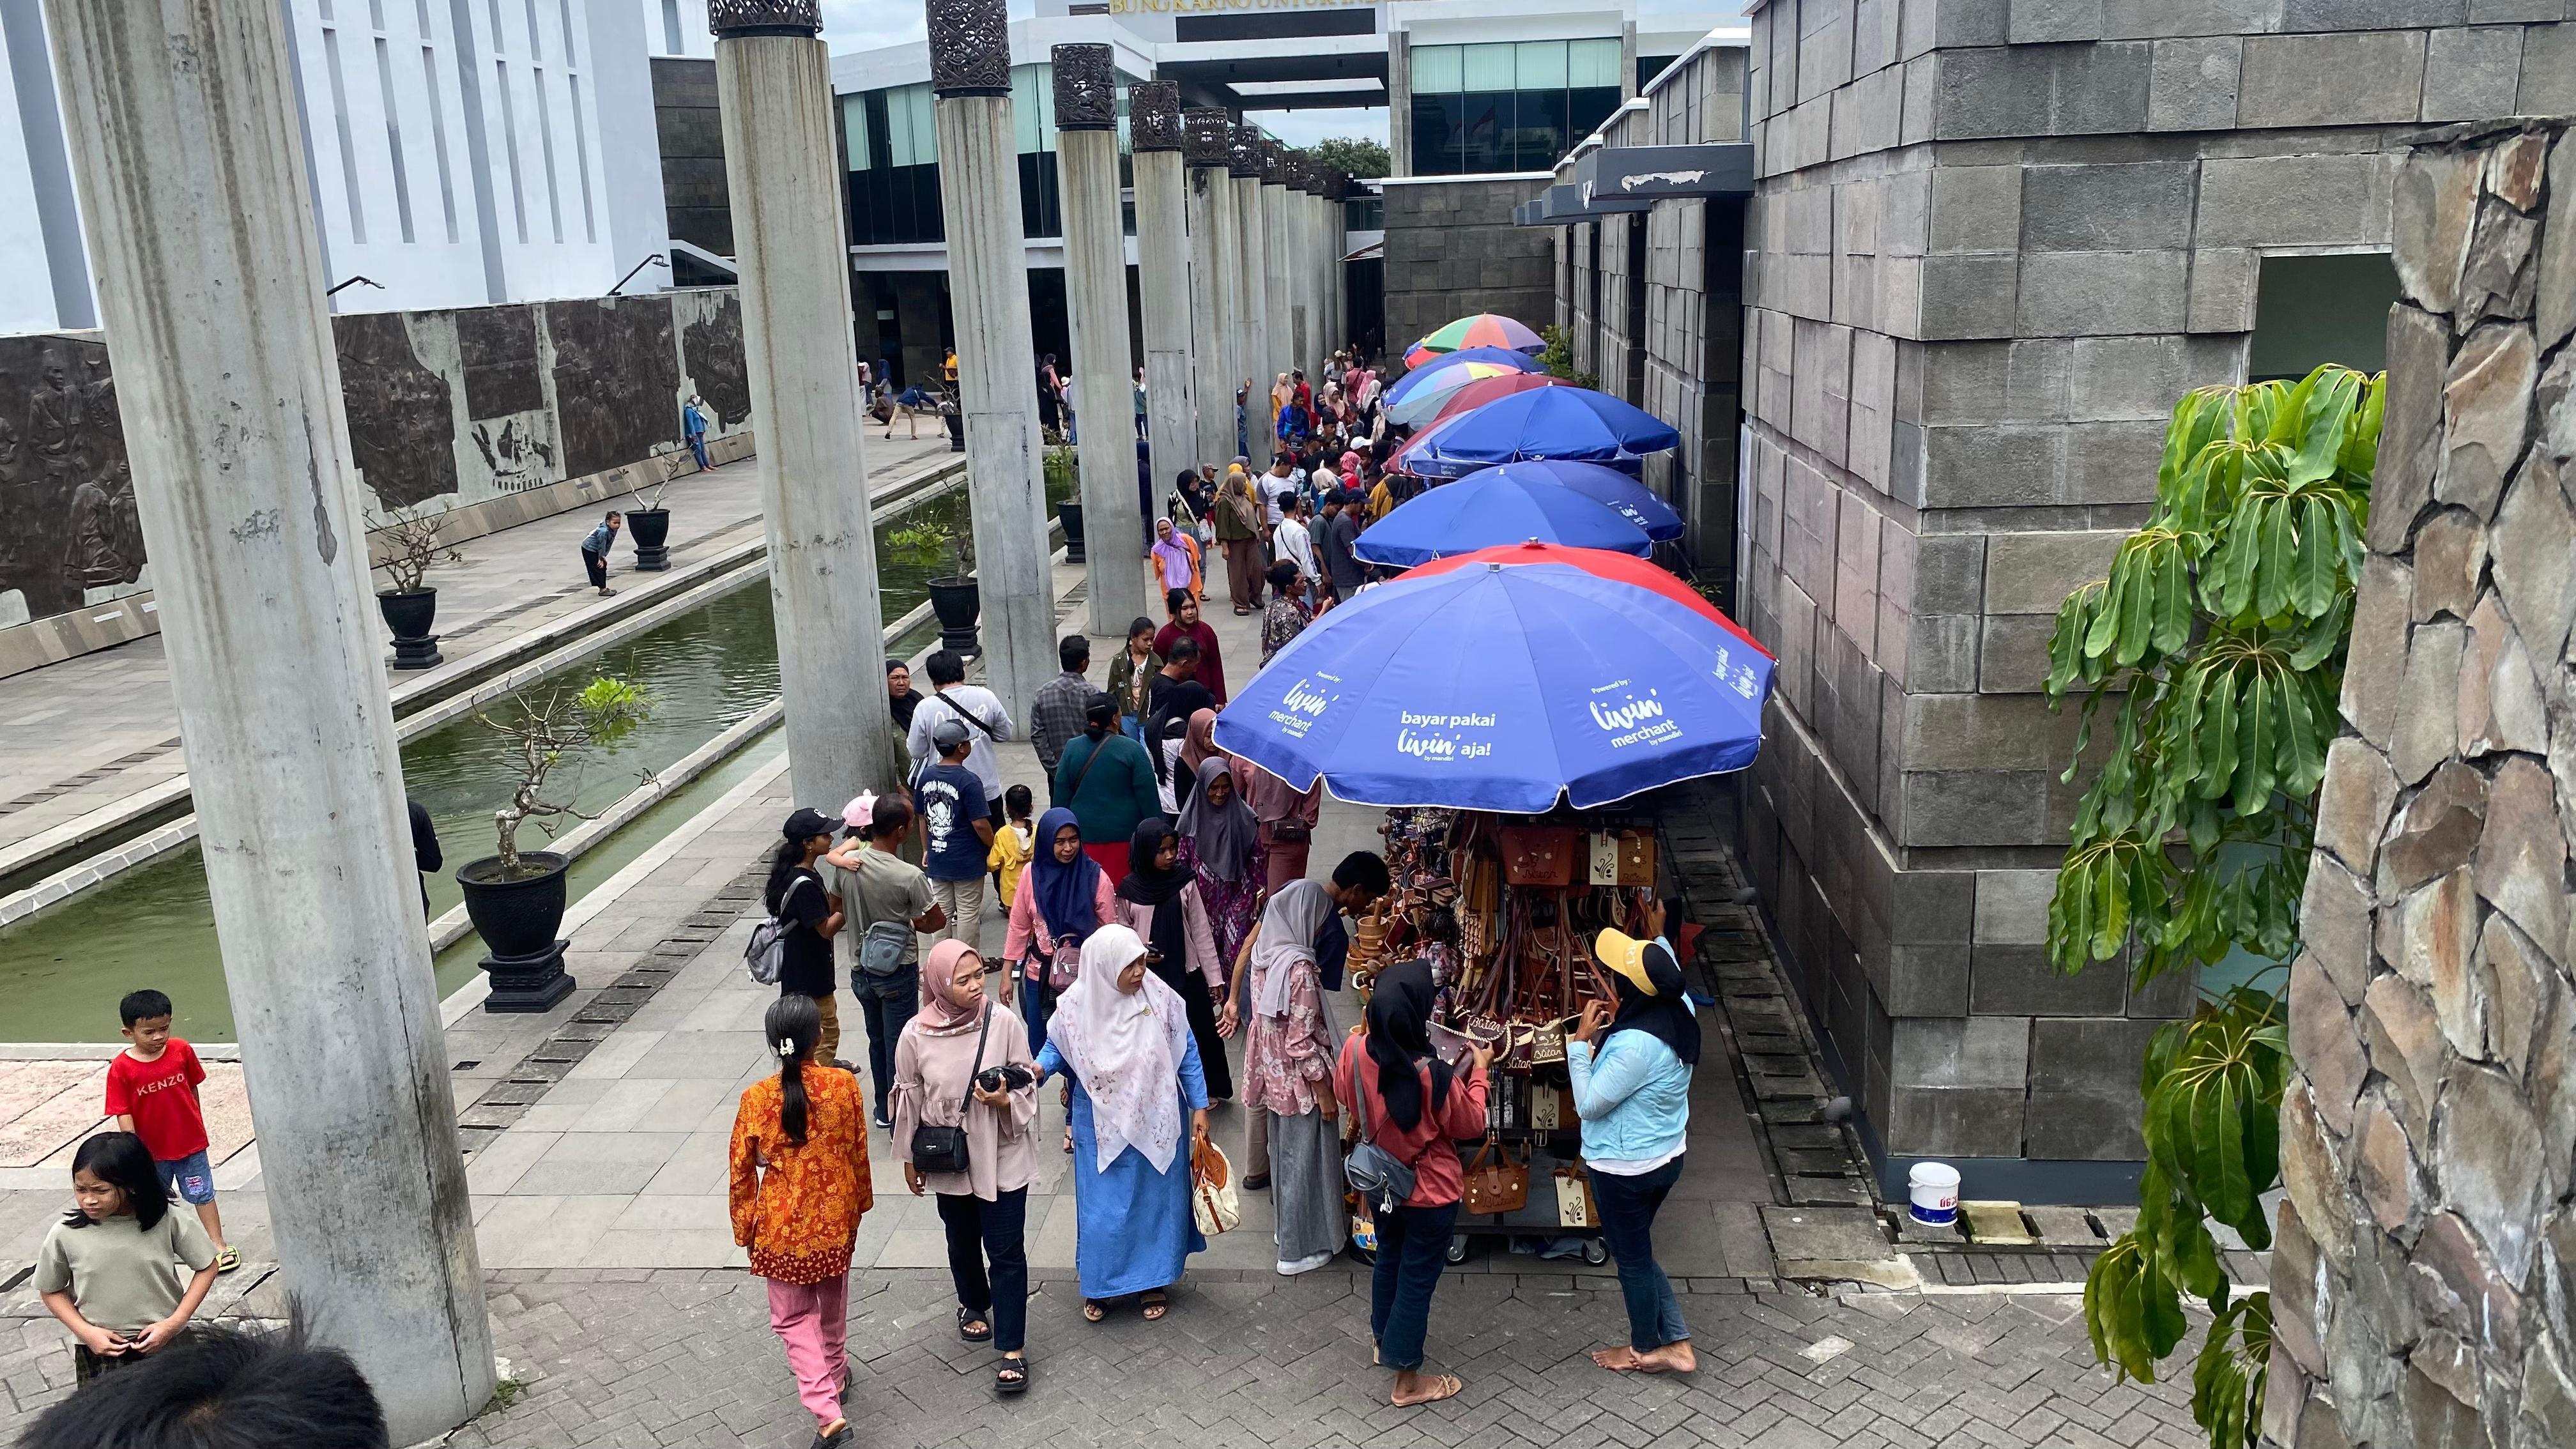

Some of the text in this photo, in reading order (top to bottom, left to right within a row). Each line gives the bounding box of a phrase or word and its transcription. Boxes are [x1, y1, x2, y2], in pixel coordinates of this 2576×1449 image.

[493, 477, 543, 491] INDONESIA
[1591, 681, 1619, 694] Powered
[1268, 710, 1312, 732] merchant
[1401, 710, 1496, 729] bayar pakai
[1611, 719, 1678, 748] merchant
[1658, 730, 1683, 743] mandiri
[1460, 742, 1492, 759] aja!
[136, 1073, 185, 1096] KENZO
